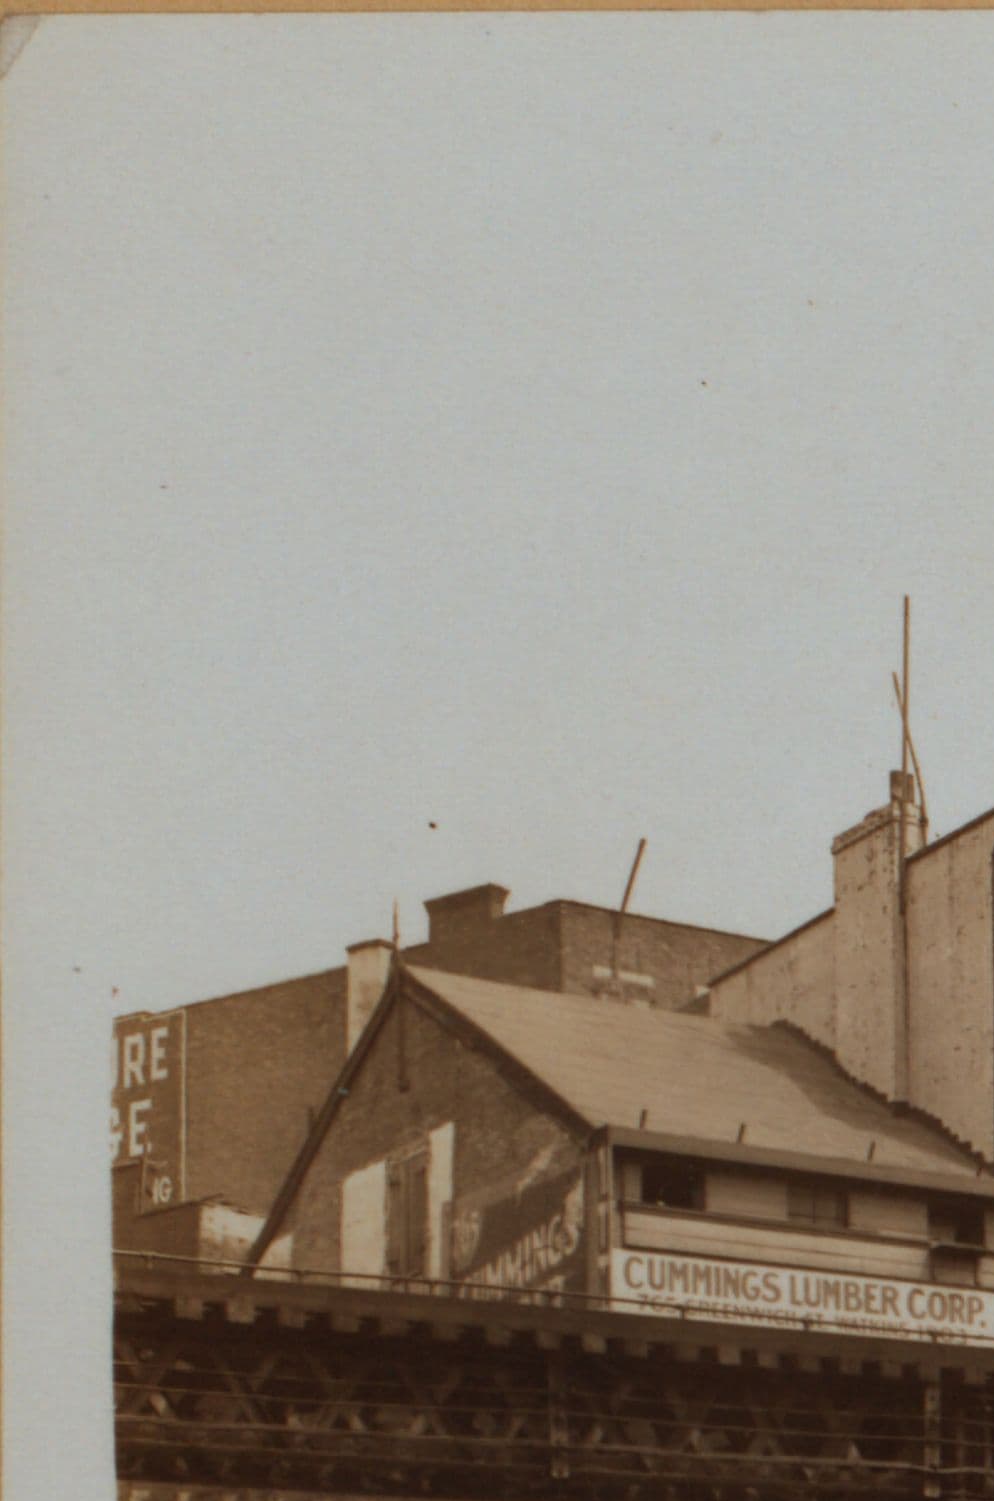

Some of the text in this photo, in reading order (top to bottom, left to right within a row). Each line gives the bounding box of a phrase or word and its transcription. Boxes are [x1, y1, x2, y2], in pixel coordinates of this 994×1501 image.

[624, 1256, 988, 1328] CUMMINGS LUMBER CORP.
